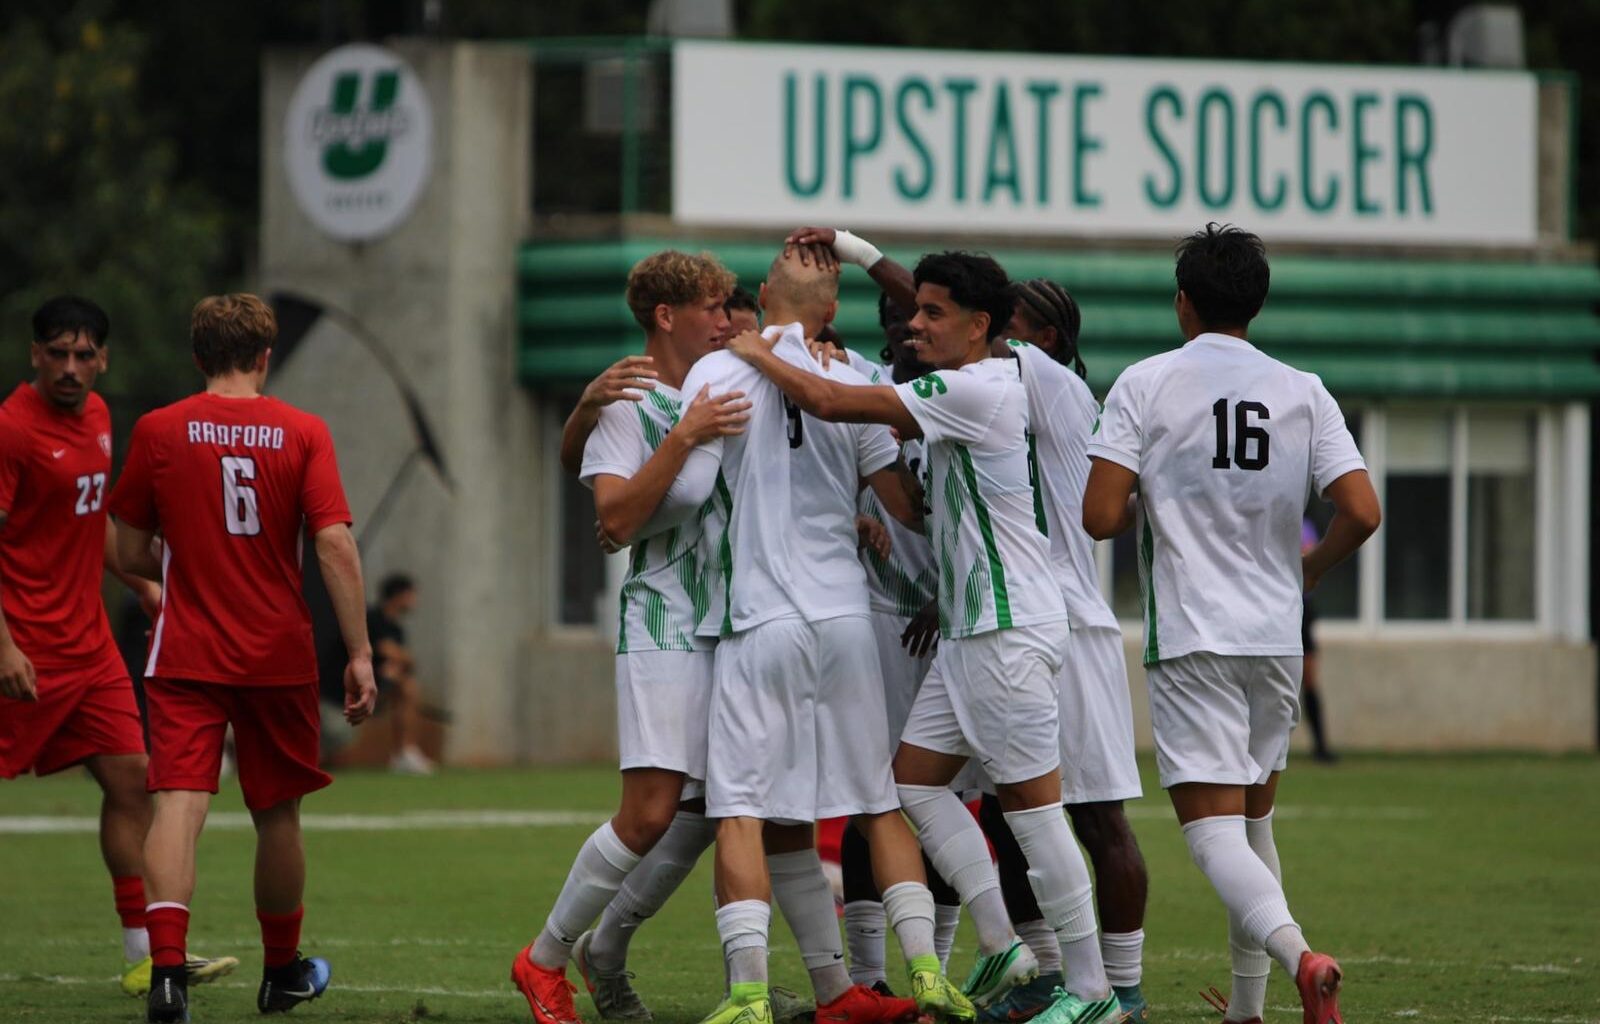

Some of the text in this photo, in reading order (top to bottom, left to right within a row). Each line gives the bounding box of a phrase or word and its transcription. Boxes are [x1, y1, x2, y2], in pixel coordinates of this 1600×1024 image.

[783, 70, 1437, 216] UPSTATE SOCCER
[187, 420, 285, 450] RADFORD
[1212, 398, 1270, 471] 16
[75, 472, 106, 515] 23
[220, 455, 261, 536] 6
